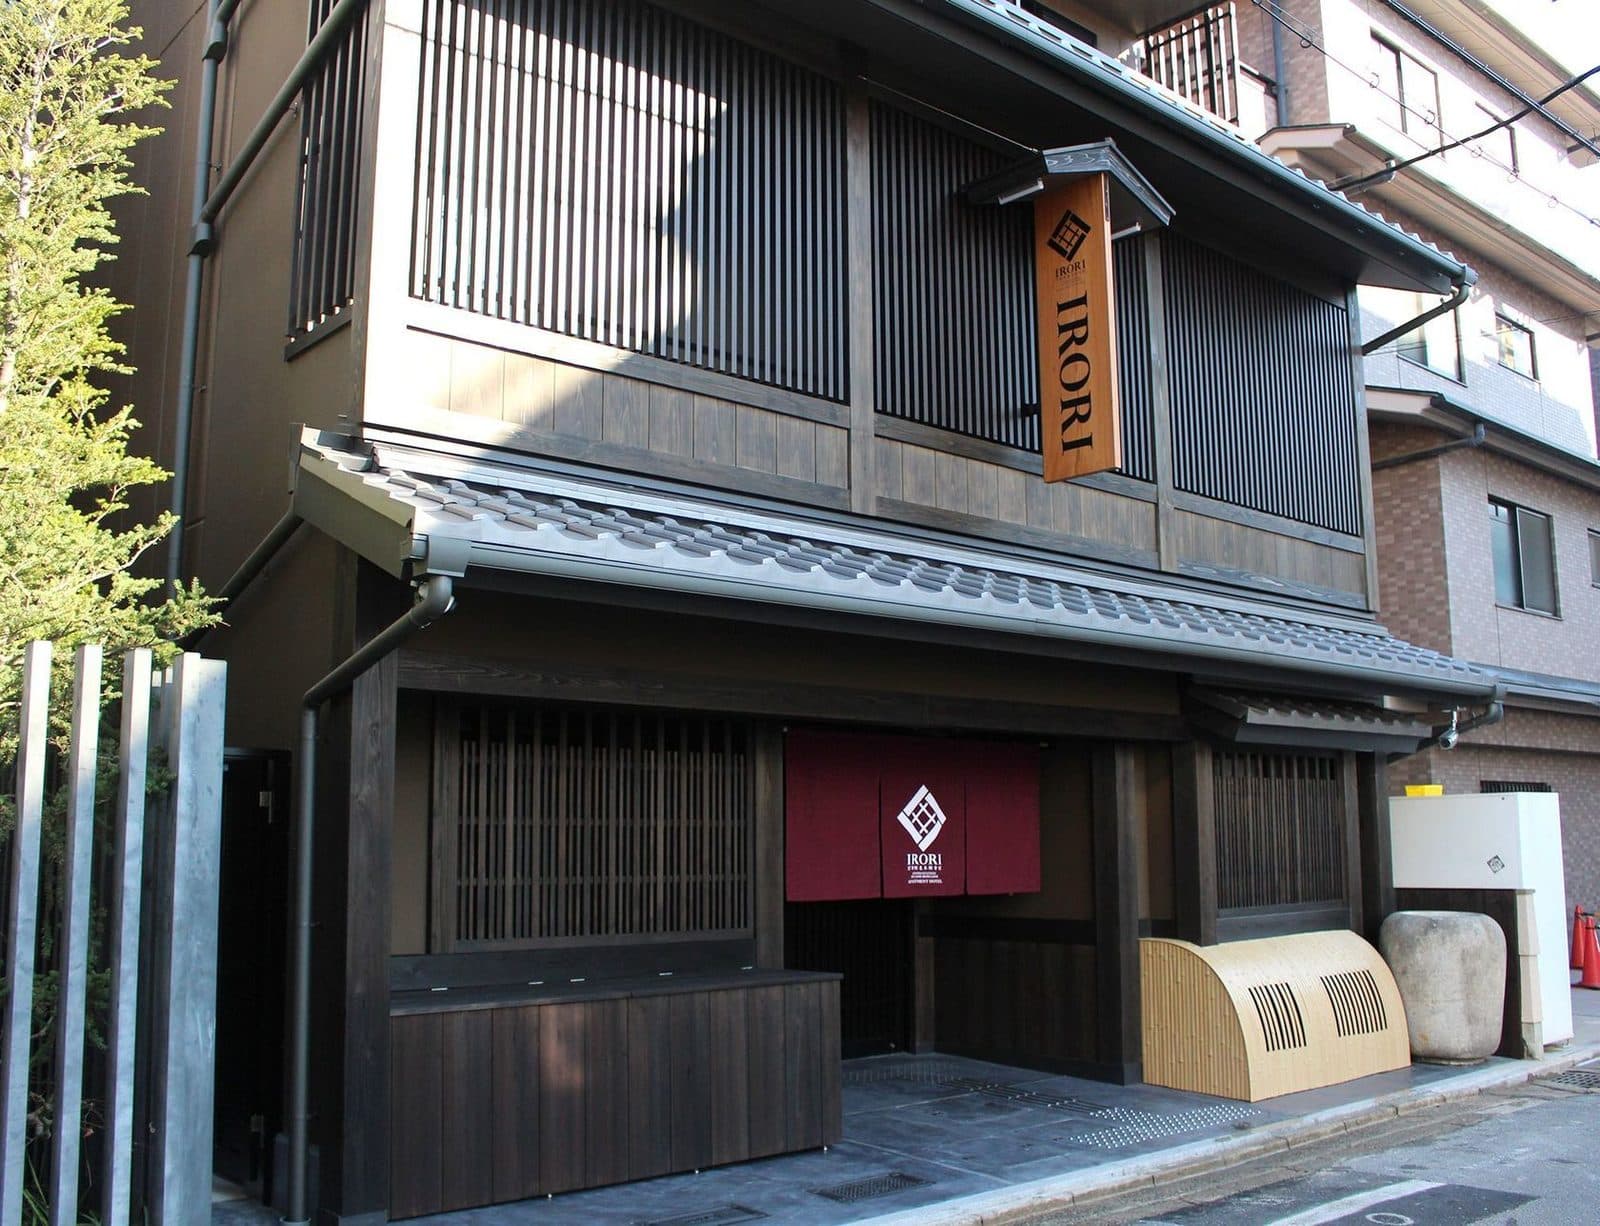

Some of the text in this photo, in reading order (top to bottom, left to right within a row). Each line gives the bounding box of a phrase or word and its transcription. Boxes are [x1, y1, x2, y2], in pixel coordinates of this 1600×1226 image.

[1055, 259, 1086, 278] IRORI
[1057, 290, 1093, 457] IRORI
[907, 853, 942, 865] IRORI
